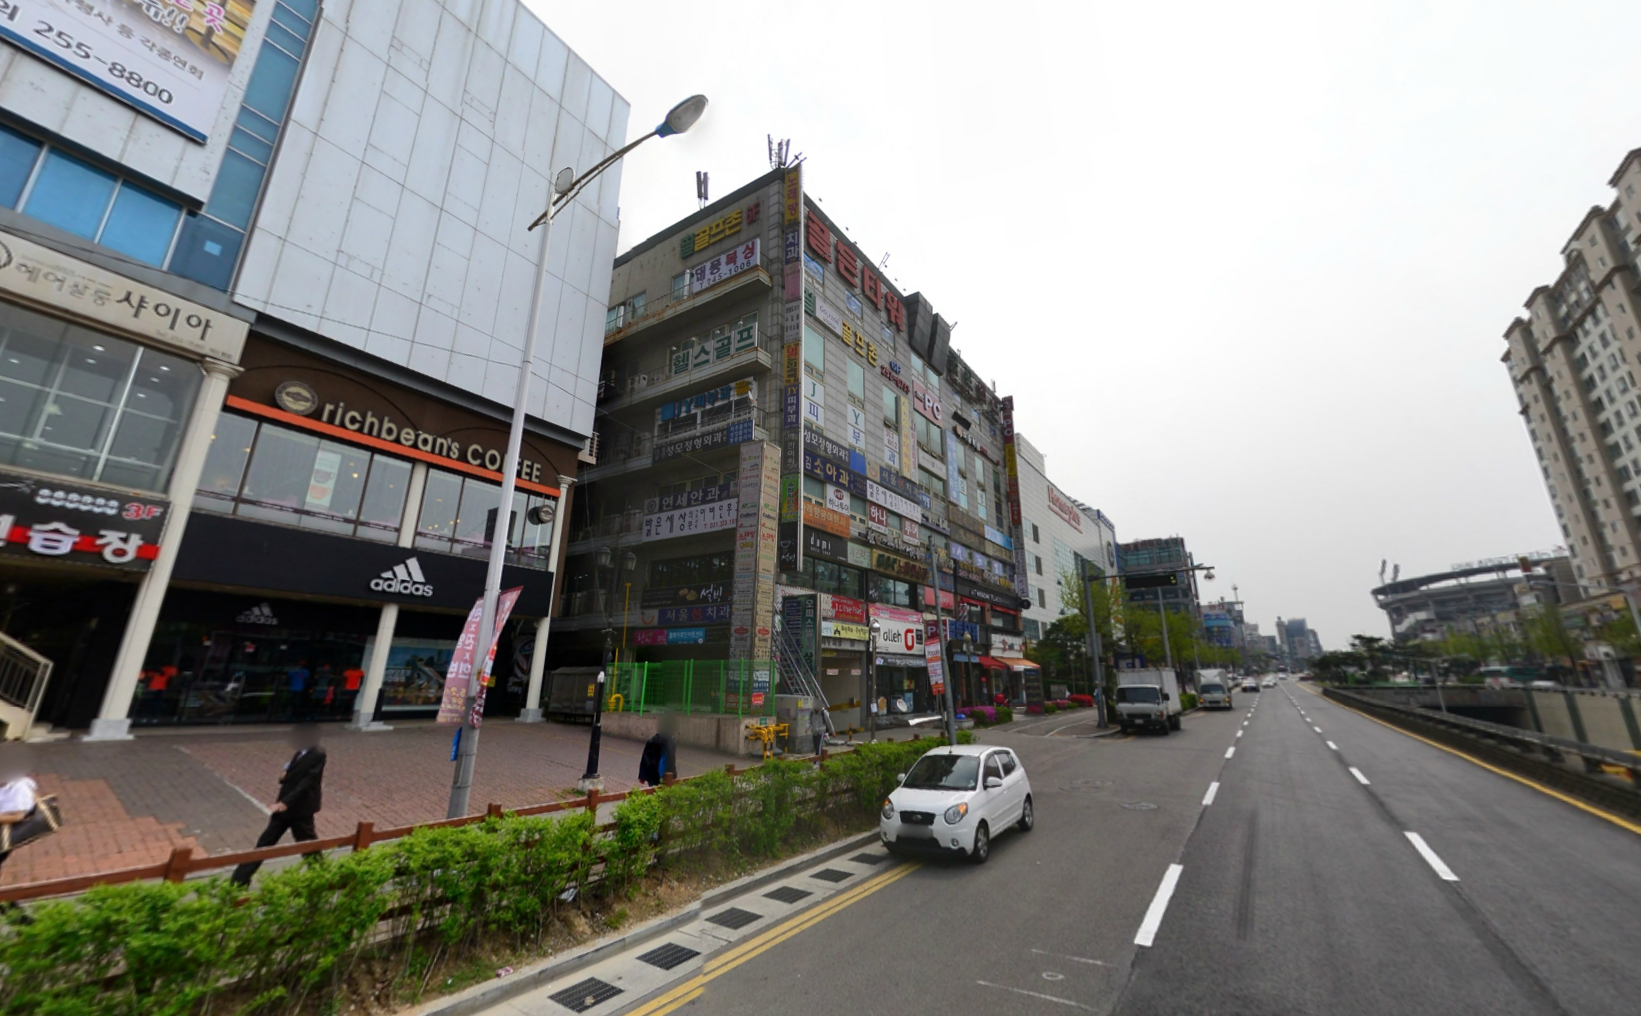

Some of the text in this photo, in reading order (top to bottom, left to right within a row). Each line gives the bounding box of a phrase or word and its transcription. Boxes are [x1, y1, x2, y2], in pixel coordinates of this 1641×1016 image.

[32, 19, 173, 104] 255-8800
[786, 231, 800, 260] 치과
[807, 210, 904, 332] 골든타워
[115, 290, 213, 341] 샤이아
[320, 401, 460, 460] richbean's
[121, 502, 164, 520] 3F
[662, 485, 720, 511] 연세안과
[870, 505, 887, 525] 하나
[369, 576, 434, 598] adidas
[883, 628, 902, 643] olleh
